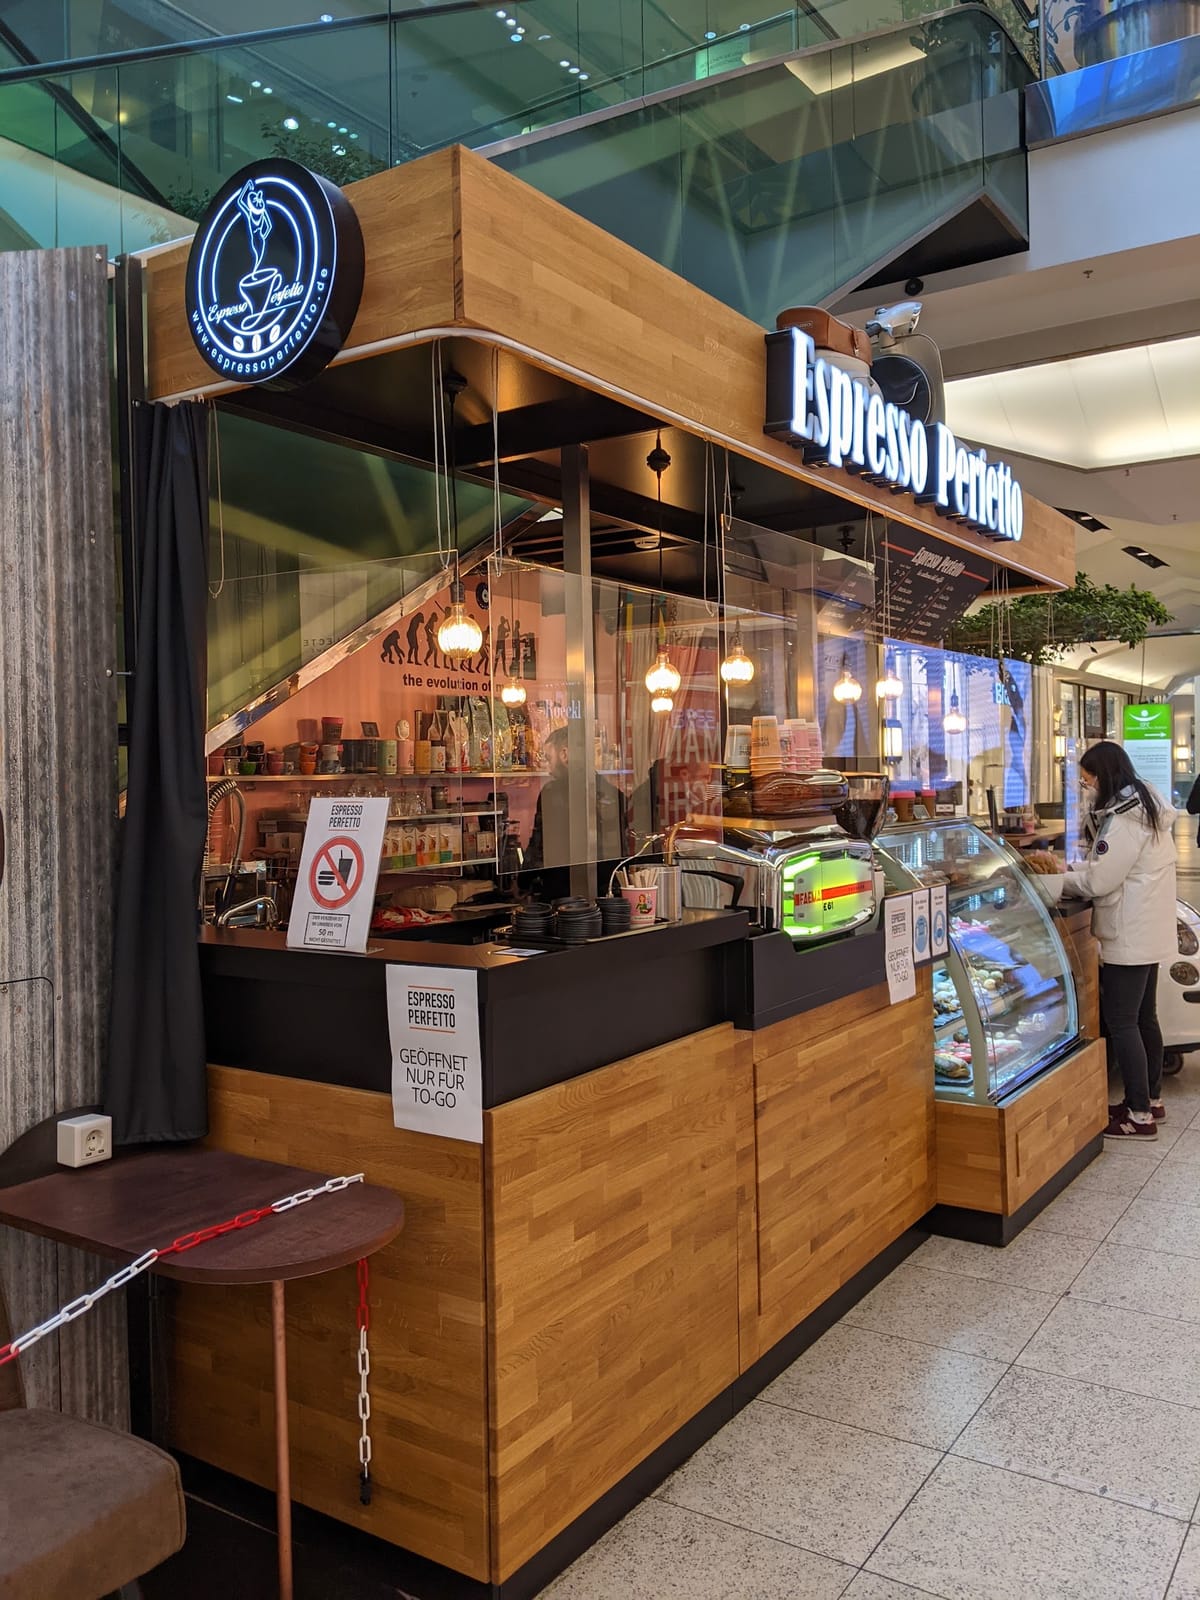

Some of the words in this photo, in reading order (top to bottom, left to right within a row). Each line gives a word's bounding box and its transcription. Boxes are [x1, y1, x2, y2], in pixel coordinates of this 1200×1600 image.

[192, 267, 329, 373] www.espressoperfetto.de
[208, 302, 249, 324] Espresso
[790, 326, 929, 494] Espresso
[936, 421, 1024, 542] Perfetto
[402, 674, 423, 687] the
[427, 677, 479, 692] evolution
[481, 679, 492, 692] of
[330, 804, 364, 817] ESPRESSO
[328, 817, 362, 829] PERFETTO
[318, 928, 327, 936] 50
[407, 991, 455, 1010] ESPRESSO
[408, 1010, 456, 1028] PERFETTO
[400, 1047, 469, 1072] GEÖFFNET
[406, 1067, 436, 1088] NUR
[438, 1068, 466, 1091] FÜR
[411, 1087, 457, 1109] TO-GO
